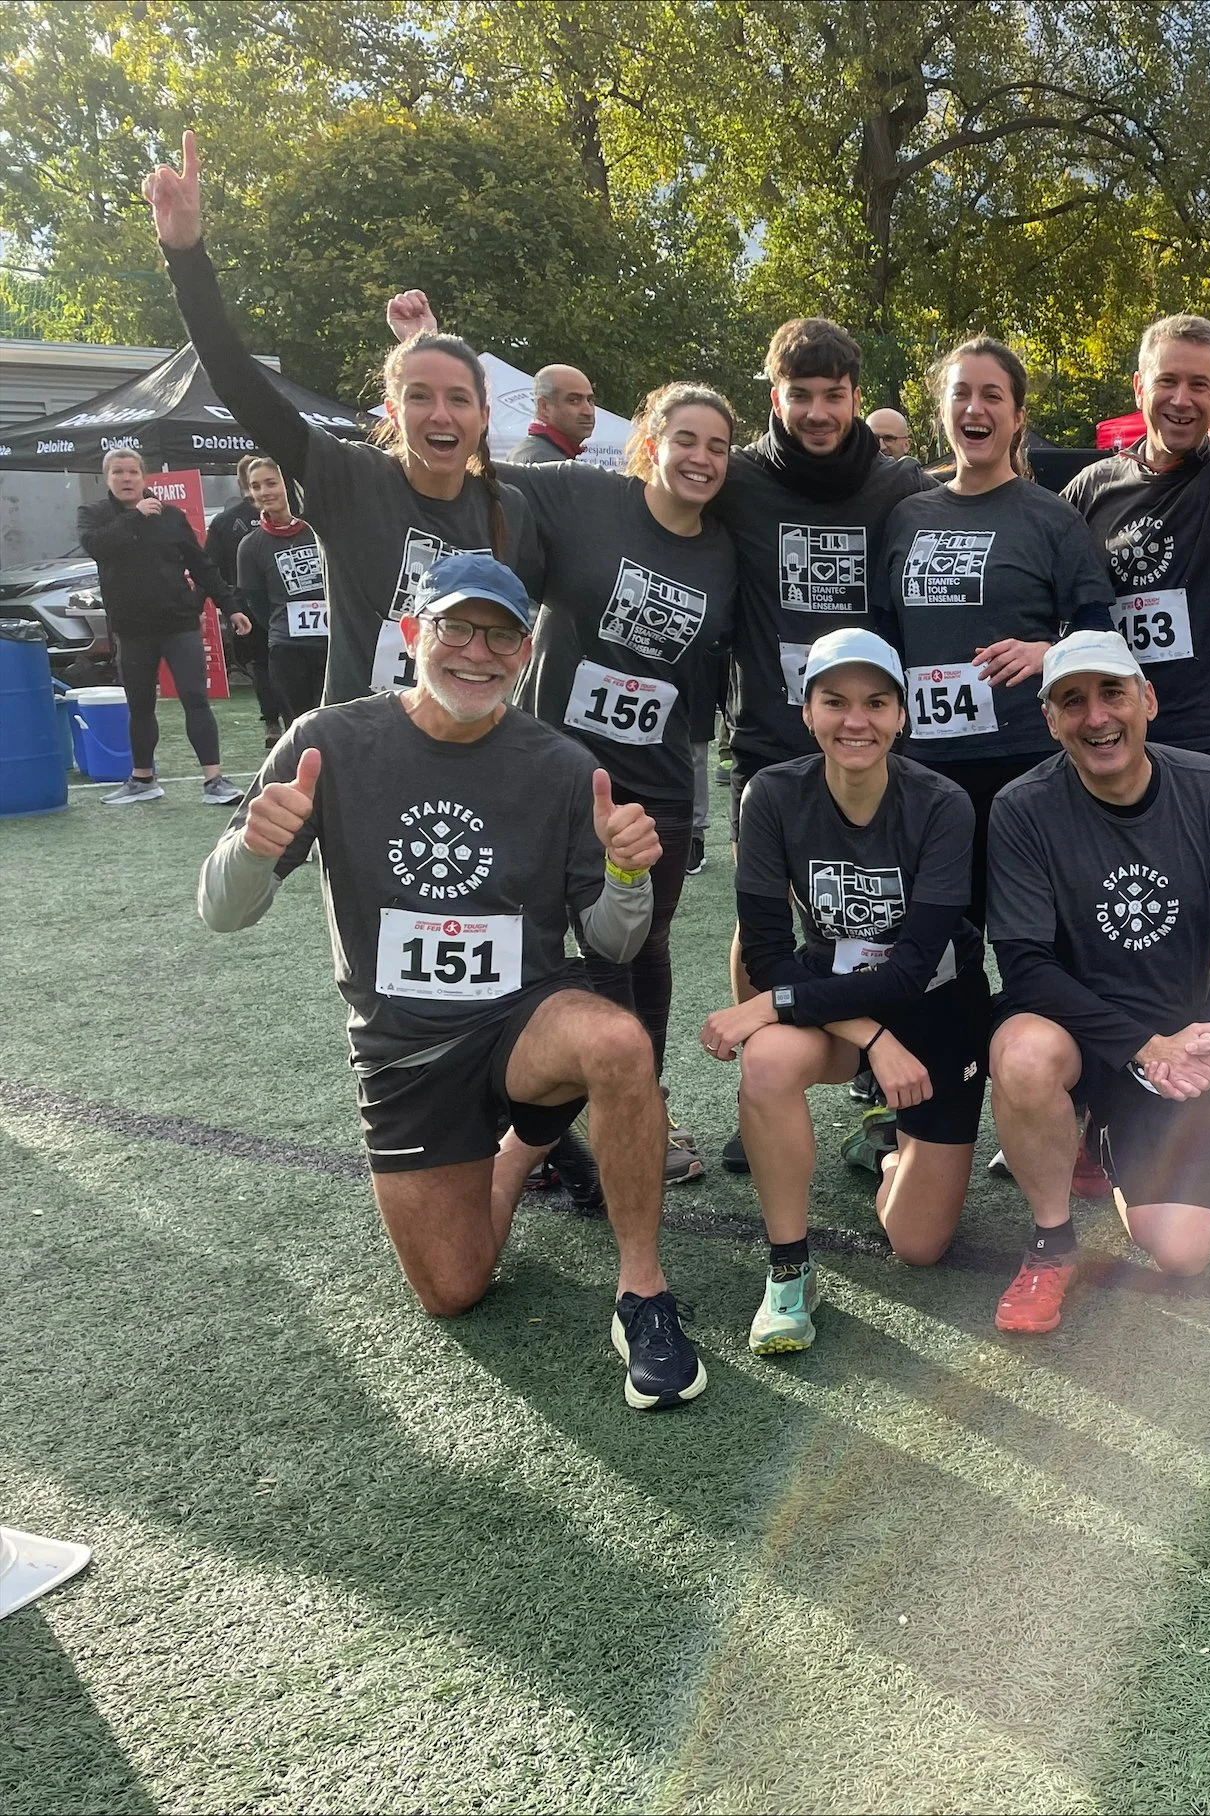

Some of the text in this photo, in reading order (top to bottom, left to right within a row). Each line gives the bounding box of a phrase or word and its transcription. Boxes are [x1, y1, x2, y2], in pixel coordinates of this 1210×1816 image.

[37, 440, 75, 453] Deloitte.
[192, 435, 259, 450] Deloitte.
[1110, 549, 1129, 582] TOUS
[1132, 535, 1174, 586] ENSEMBLE
[811, 586, 846, 595] STANTEC
[927, 577, 961, 586] STANTEC
[927, 585, 948, 595] TOUS
[811, 594, 833, 602] TOUS
[812, 602, 852, 611] ENSEMBLE
[928, 594, 967, 603] ENSEMBLE
[631, 634, 651, 646] TOUS
[634, 626, 667, 644] STANTEC
[1118, 612, 1176, 650] 153
[584, 687, 661, 733] 156
[915, 684, 979, 724] 154
[400, 800, 484, 832] STANTEC
[388, 838, 416, 886] TOUS
[419, 847, 493, 900] ENSEMBLE
[1103, 863, 1169, 891] STANTEC
[849, 927, 880, 937] STANTE
[1096, 902, 1120, 941] TOUS
[1123, 899, 1179, 951] ENSEMBLE
[401, 937, 500, 984] 151
